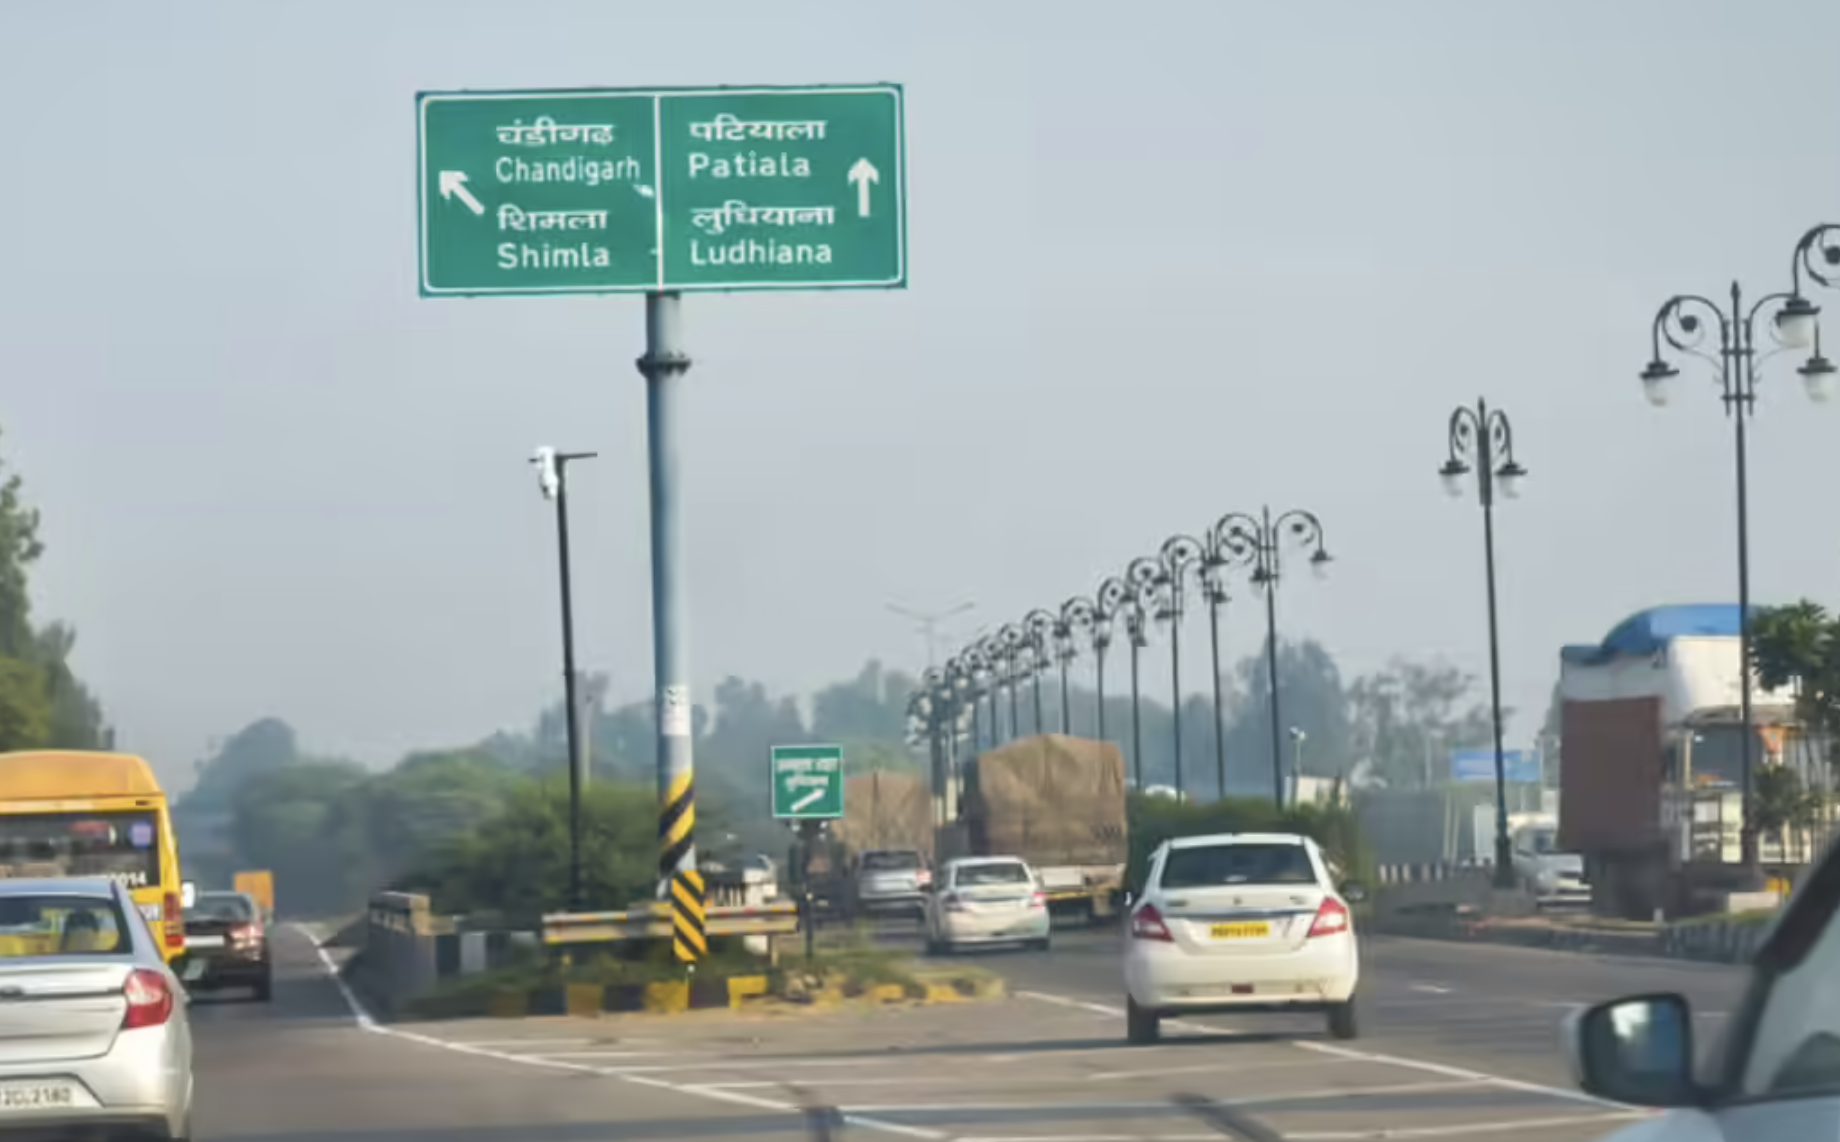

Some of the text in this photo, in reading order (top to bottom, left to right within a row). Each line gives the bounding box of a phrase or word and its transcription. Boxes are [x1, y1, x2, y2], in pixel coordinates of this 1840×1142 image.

[688, 112, 828, 141] पटियाला
[495, 155, 641, 186] Chandigarh
[688, 150, 812, 178] Patiala
[496, 202, 608, 231] शिमला
[689, 199, 835, 235] लुधियाना
[497, 242, 610, 269] Shimla
[691, 238, 832, 266] Ludhiana
